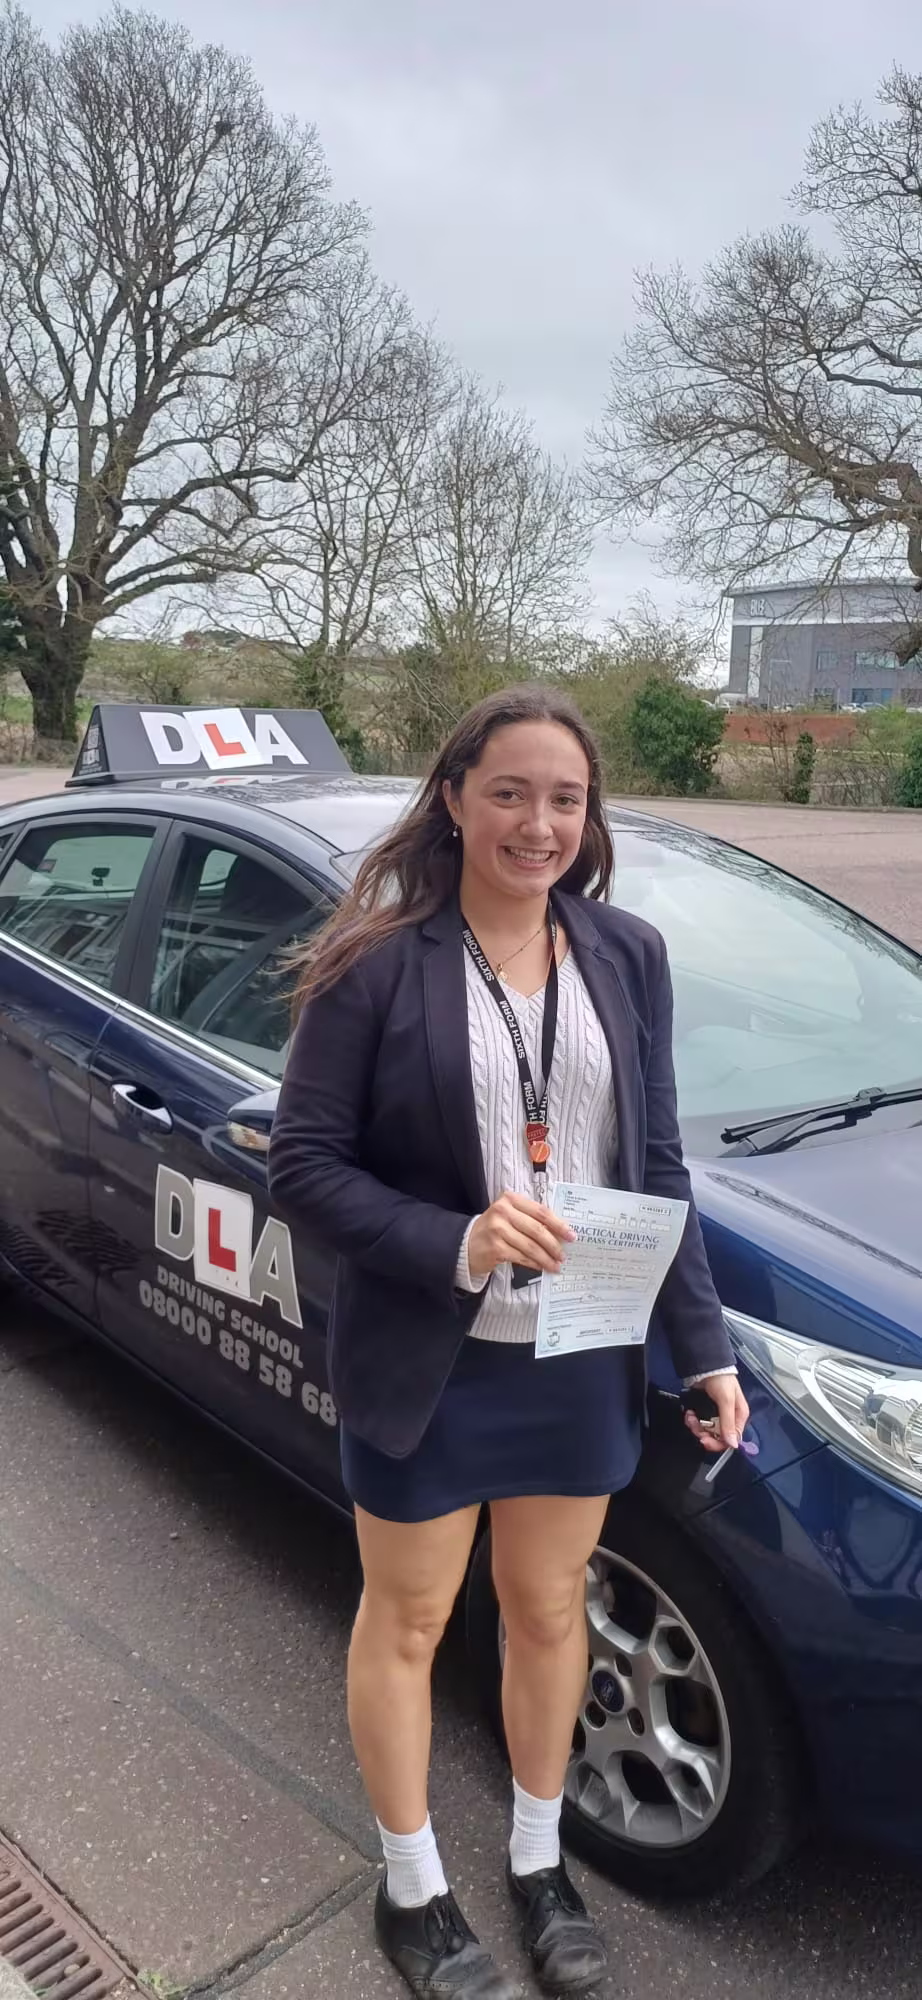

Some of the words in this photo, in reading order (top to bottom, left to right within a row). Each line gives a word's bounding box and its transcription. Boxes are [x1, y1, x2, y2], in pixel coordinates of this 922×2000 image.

[139, 710, 309, 767] DLA
[462, 929, 480, 955] FORM
[475, 955, 495, 982] SIXTH
[500, 1000, 517, 1028] FORM
[512, 1028, 525, 1059] SIXTH
[523, 1081, 537, 1110] FORM
[155, 1163, 303, 1329] DLA
[608, 1239, 657, 1250] CERTIFICATE
[619, 1231, 660, 1244] DRIVING
[157, 1265, 225, 1321] DRIVING
[231, 1309, 303, 1368] SCHOOL
[139, 1280, 211, 1345] 08000
[219, 1329, 250, 1372] 88
[259, 1353, 292, 1397] 58
[302, 1381, 337, 1427] 68
